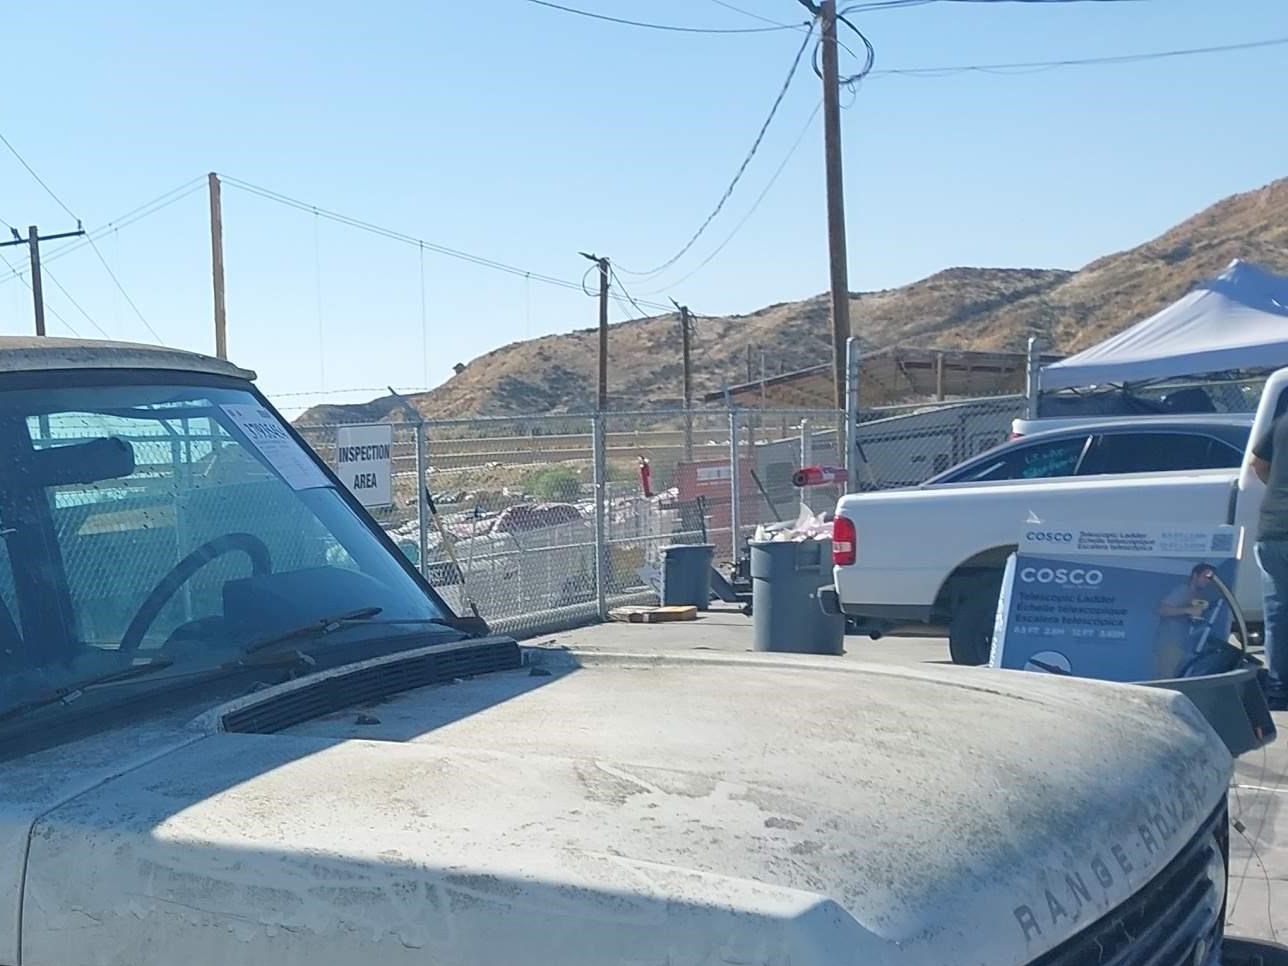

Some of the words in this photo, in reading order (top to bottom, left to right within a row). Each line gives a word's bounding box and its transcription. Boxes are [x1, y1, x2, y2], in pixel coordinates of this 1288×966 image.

[339, 444, 390, 462] INSPECTION
[353, 473, 377, 489] AREA
[1026, 531, 1073, 542] COSCO
[1020, 567, 1104, 585] COSCO
[1012, 842, 1135, 942] RANGE
